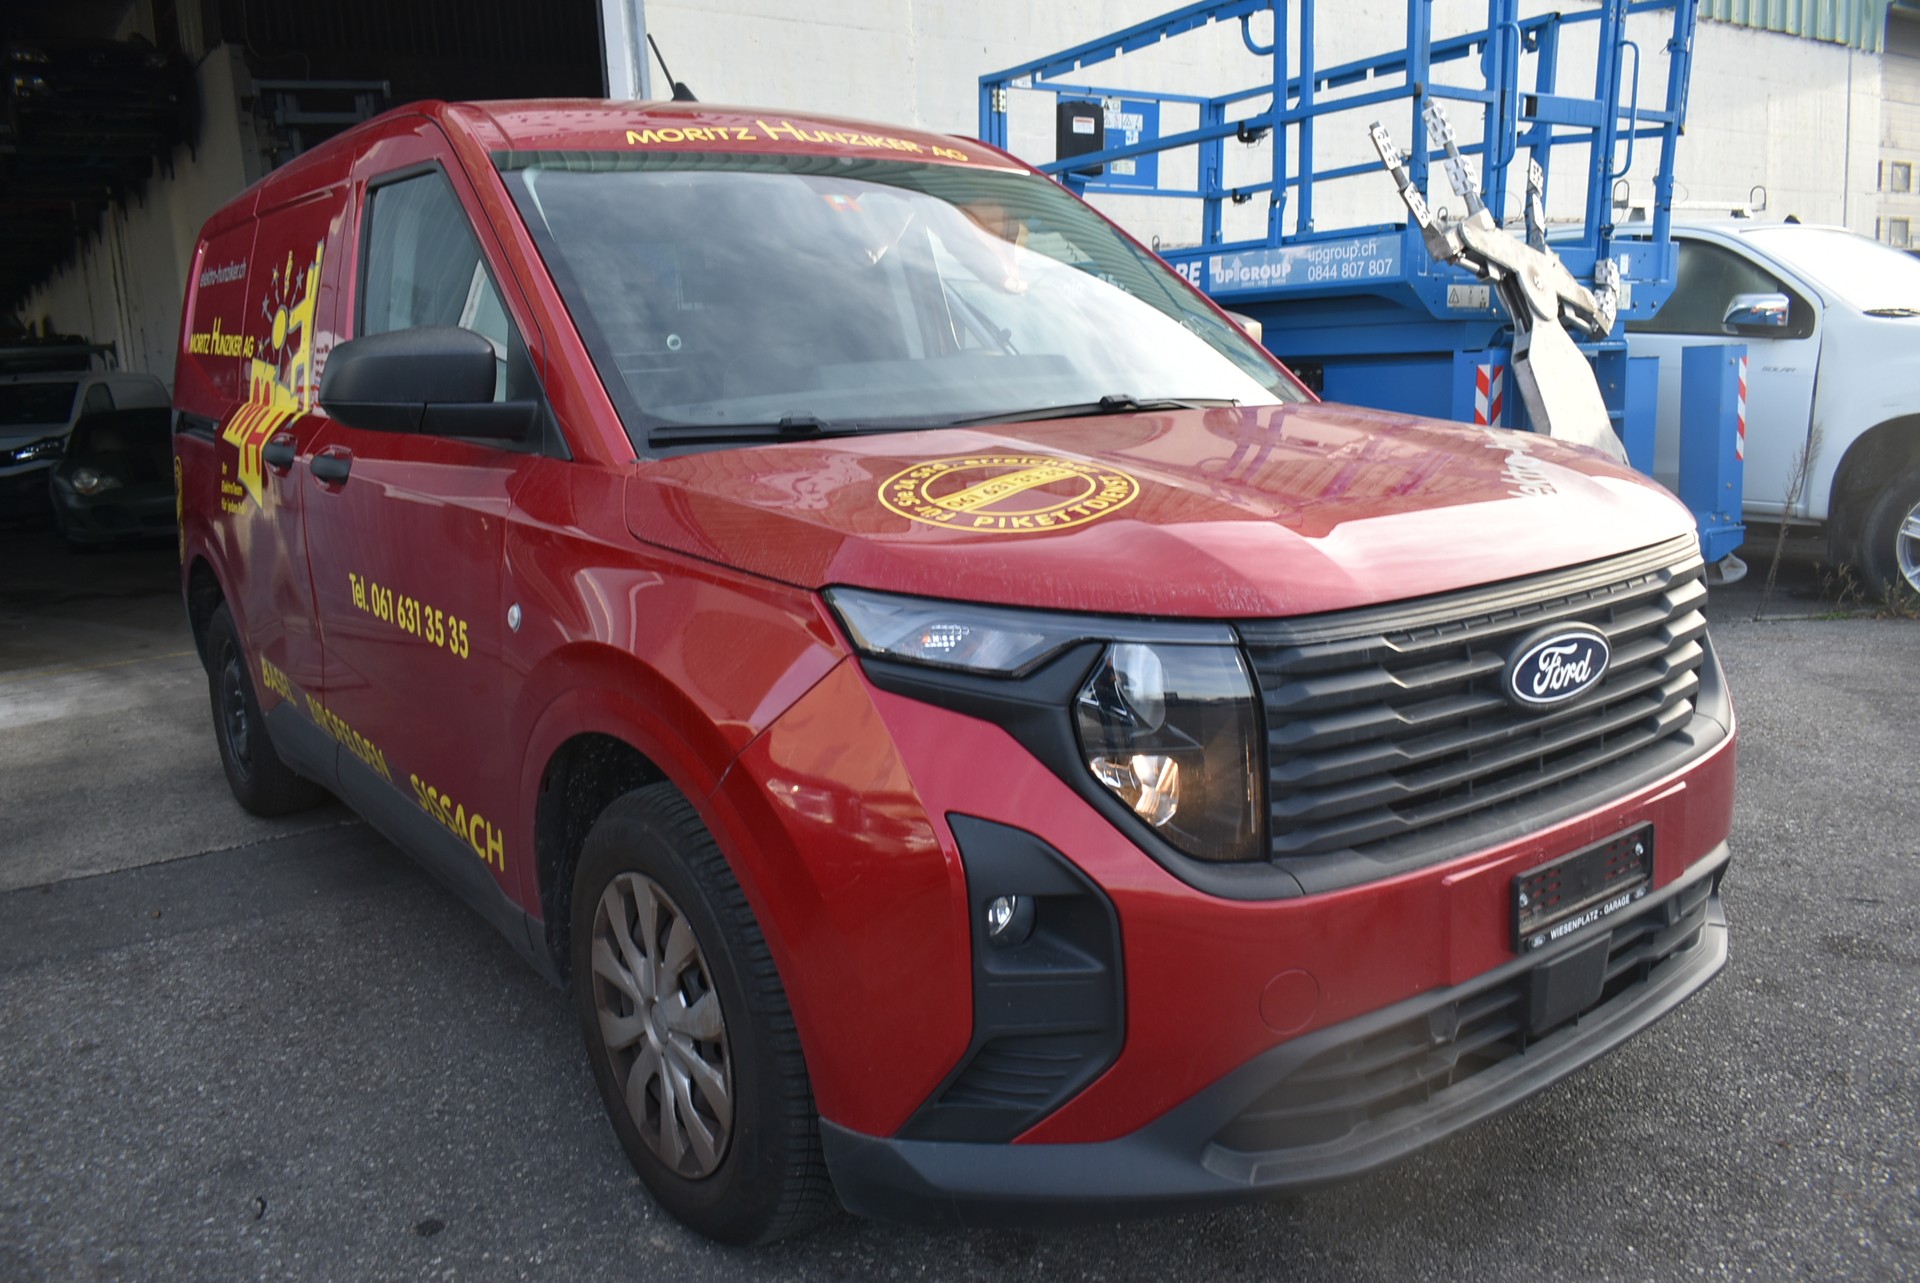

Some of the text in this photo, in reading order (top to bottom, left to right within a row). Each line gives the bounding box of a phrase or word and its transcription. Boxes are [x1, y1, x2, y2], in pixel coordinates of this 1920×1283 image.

[626, 119, 969, 163] MORITZ HUNZIKER AG
[199, 257, 247, 289] elektro-hunziker.ch
[1307, 258, 1393, 282] 0844 807 807
[1308, 239, 1377, 265] upgroup.ch
[190, 333, 211, 355] MORITZ
[242, 335, 255, 359] AG
[973, 475, 1130, 529] PIKETTDIENST
[348, 572, 469, 660] Tel. 061 631 35 35
[1533, 642, 1593, 695] Ford
[410, 773, 505, 872] SISSACH
[1549, 908, 1599, 941] WIESENPLATZ
[1603, 893, 1631, 916] GARAGE
